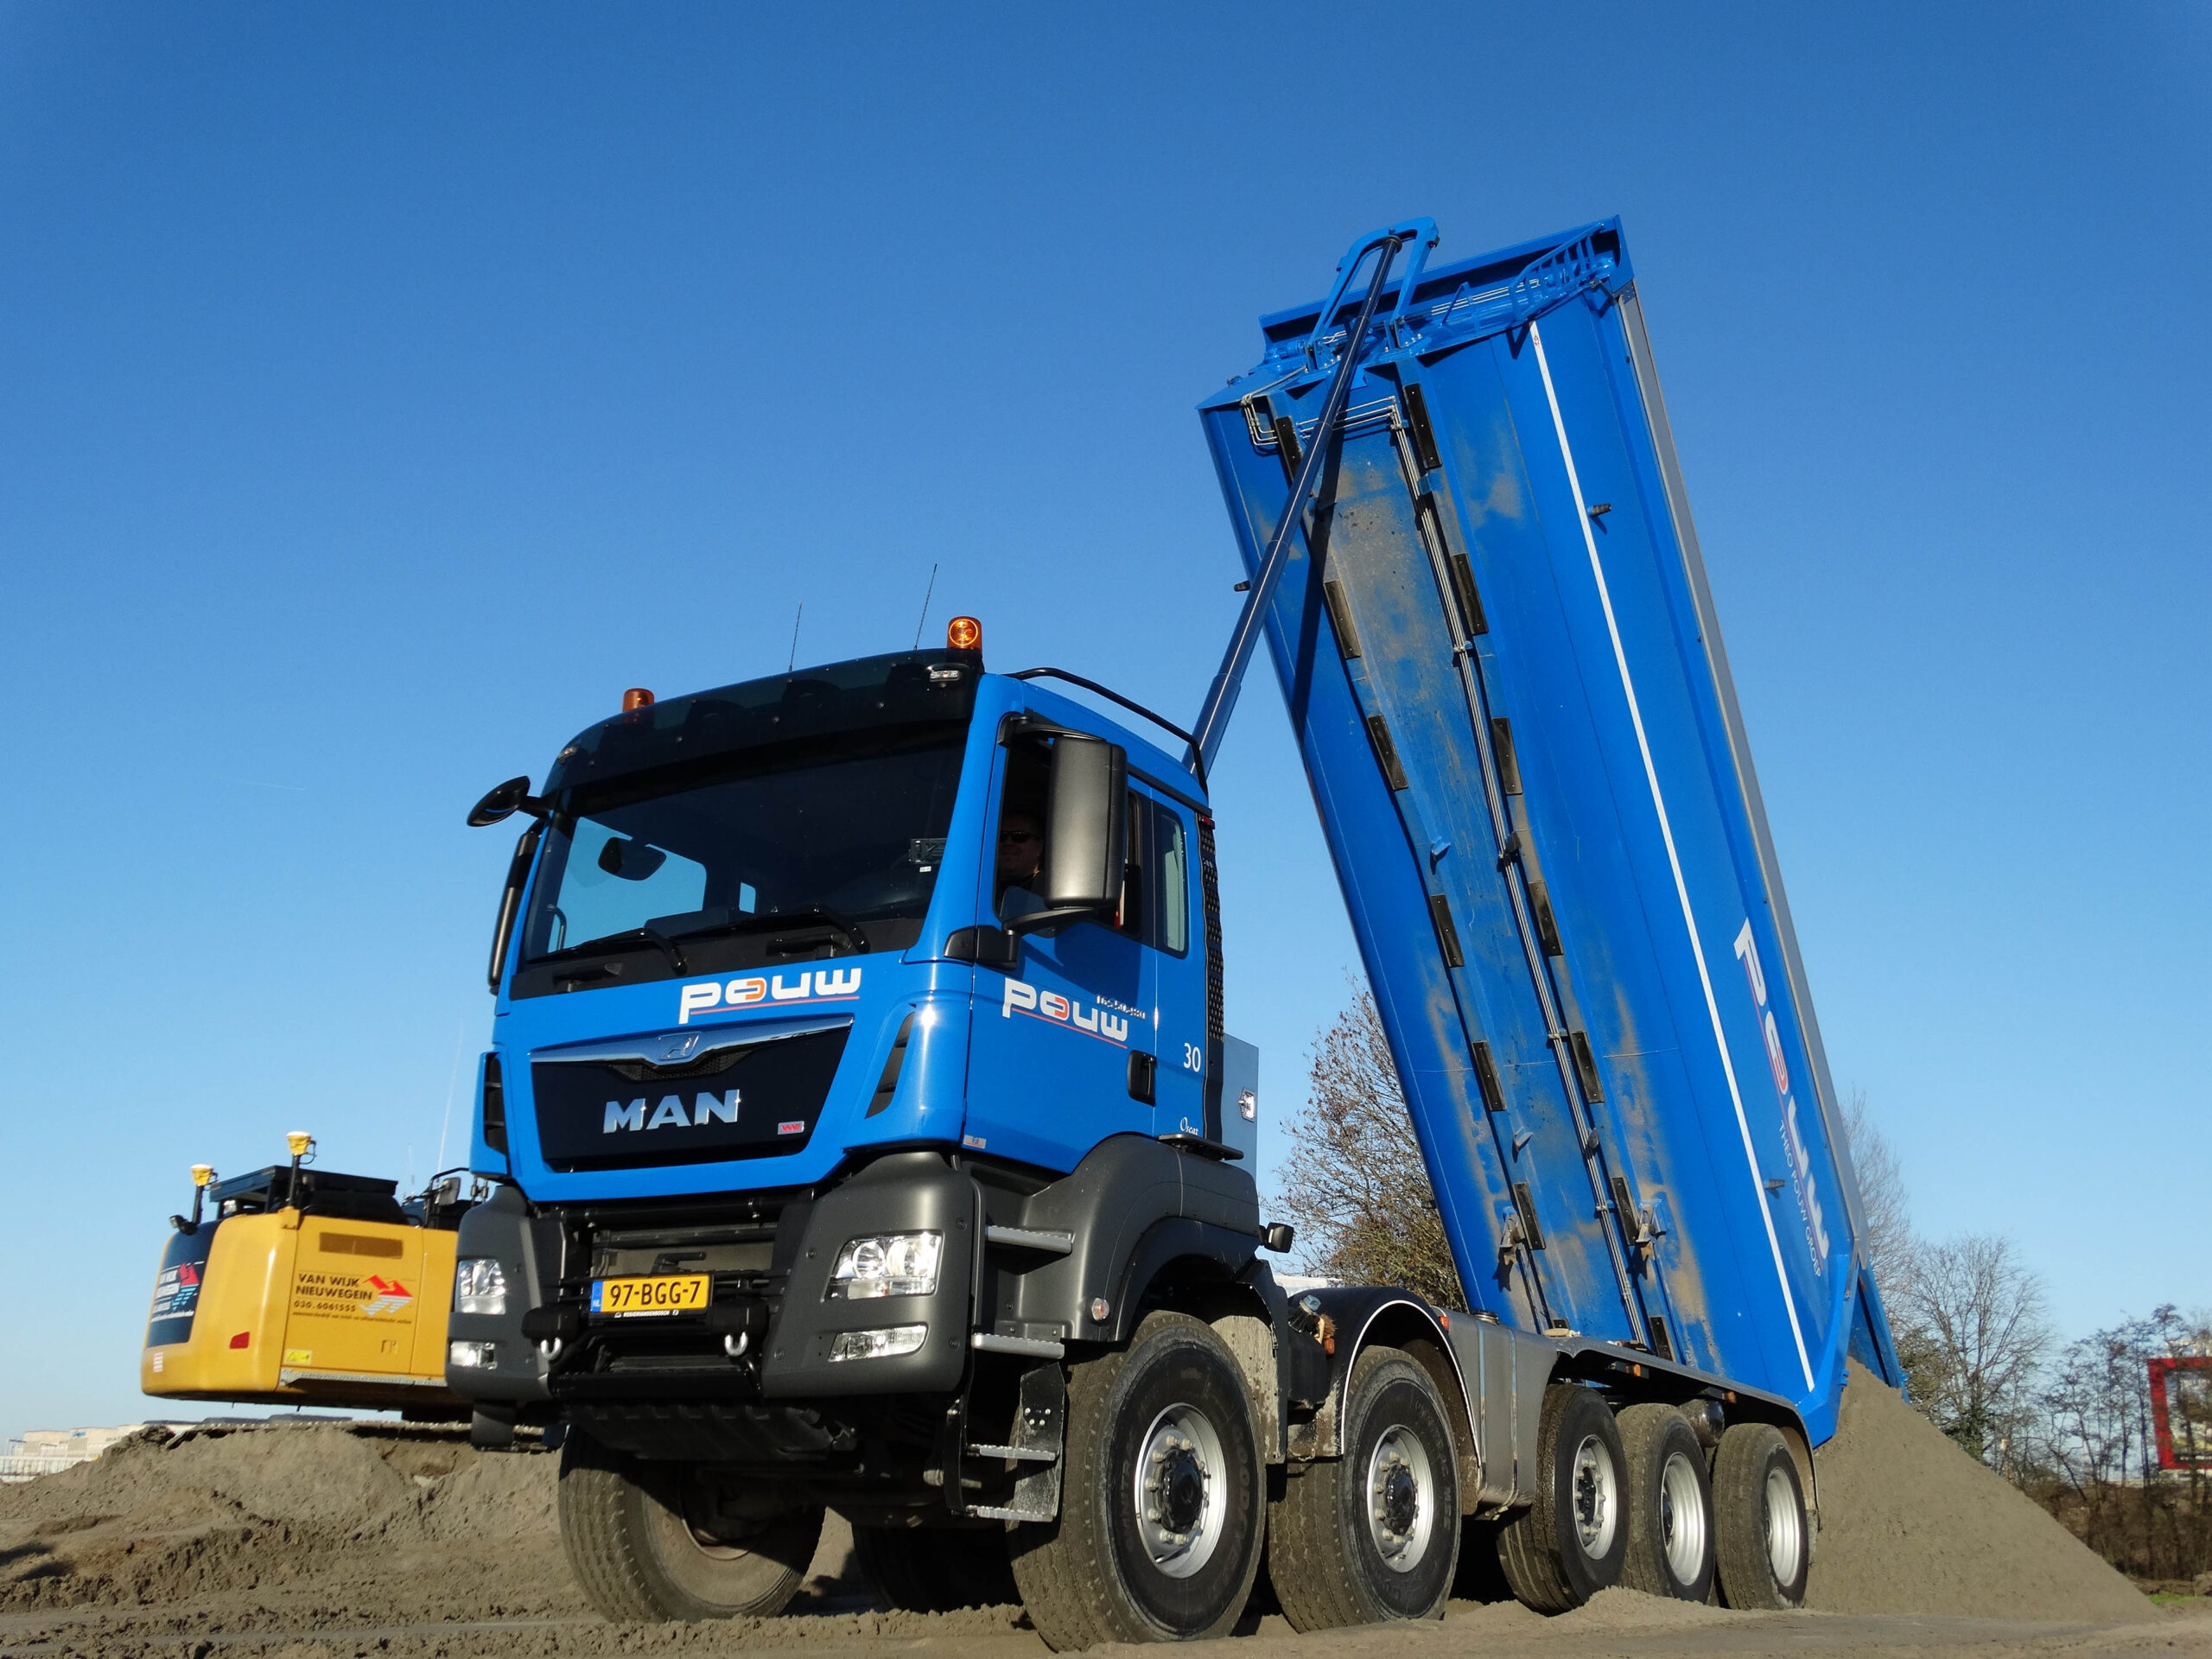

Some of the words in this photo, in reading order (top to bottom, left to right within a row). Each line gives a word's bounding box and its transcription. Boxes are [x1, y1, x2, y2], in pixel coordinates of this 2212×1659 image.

[1183, 1042, 1201, 1072] 30
[603, 1089, 740, 1134] MAN
[1778, 1119, 1794, 1167] THEO
[1790, 1170, 1808, 1221] POUW
[1805, 1225, 1821, 1277] GROEP
[296, 1285, 372, 1300] NIEUWEGEIN
[298, 1274, 325, 1284] VAN
[329, 1276, 360, 1287] WIJK
[610, 1281, 701, 1306] 97-BGG-7
